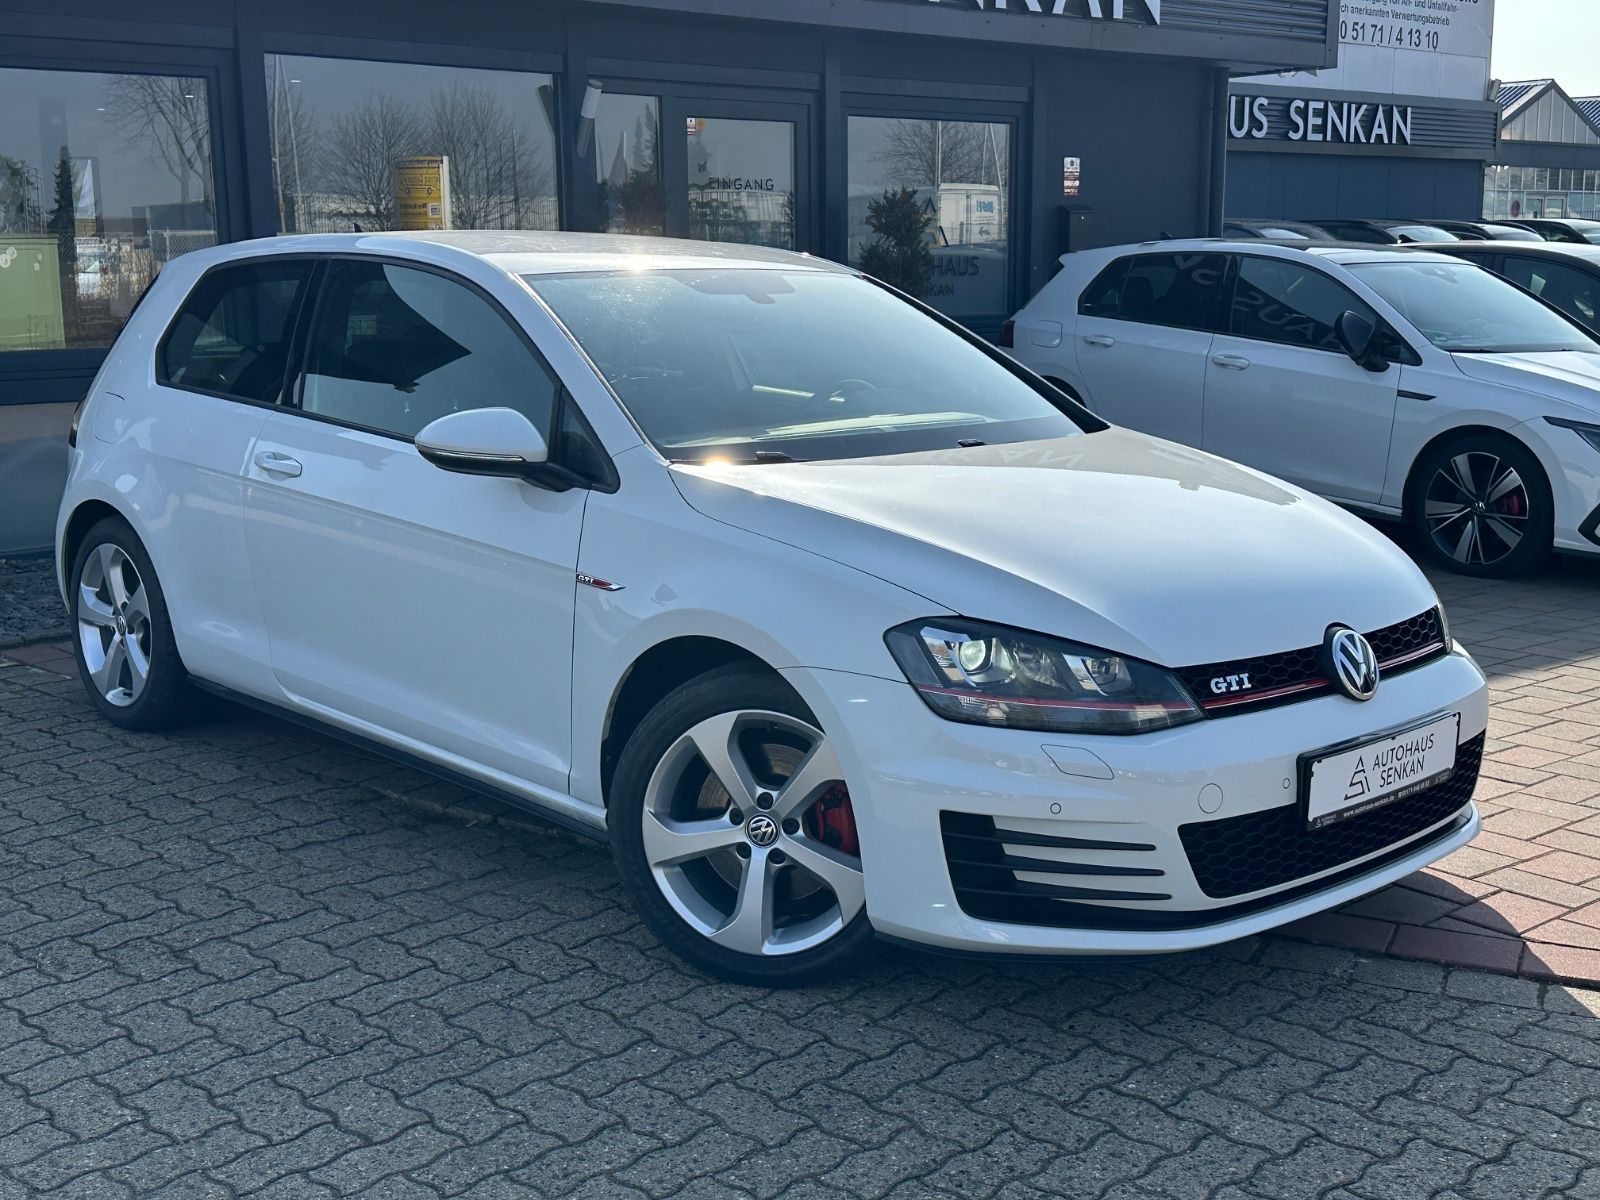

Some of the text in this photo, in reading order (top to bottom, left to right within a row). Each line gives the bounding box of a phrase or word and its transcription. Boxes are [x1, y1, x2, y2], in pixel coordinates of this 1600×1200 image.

[1340, 4, 1450, 25] ch anerkannten Verwertungsbetrieb
[1352, 22, 1365, 41] 51
[1370, 24, 1384, 44] 71
[1396, 27, 1403, 45] 4
[1408, 28, 1421, 48] 13
[1425, 30, 1439, 50] 10
[1229, 96, 1412, 145] US SENKAN
[709, 177, 775, 191] EINGANG
[931, 255, 980, 276] HAUS
[578, 575, 594, 584] GTI
[1210, 672, 1252, 694] GTI
[1372, 733, 1435, 771] AUTOHAUS
[1379, 755, 1425, 788] SENKAN
